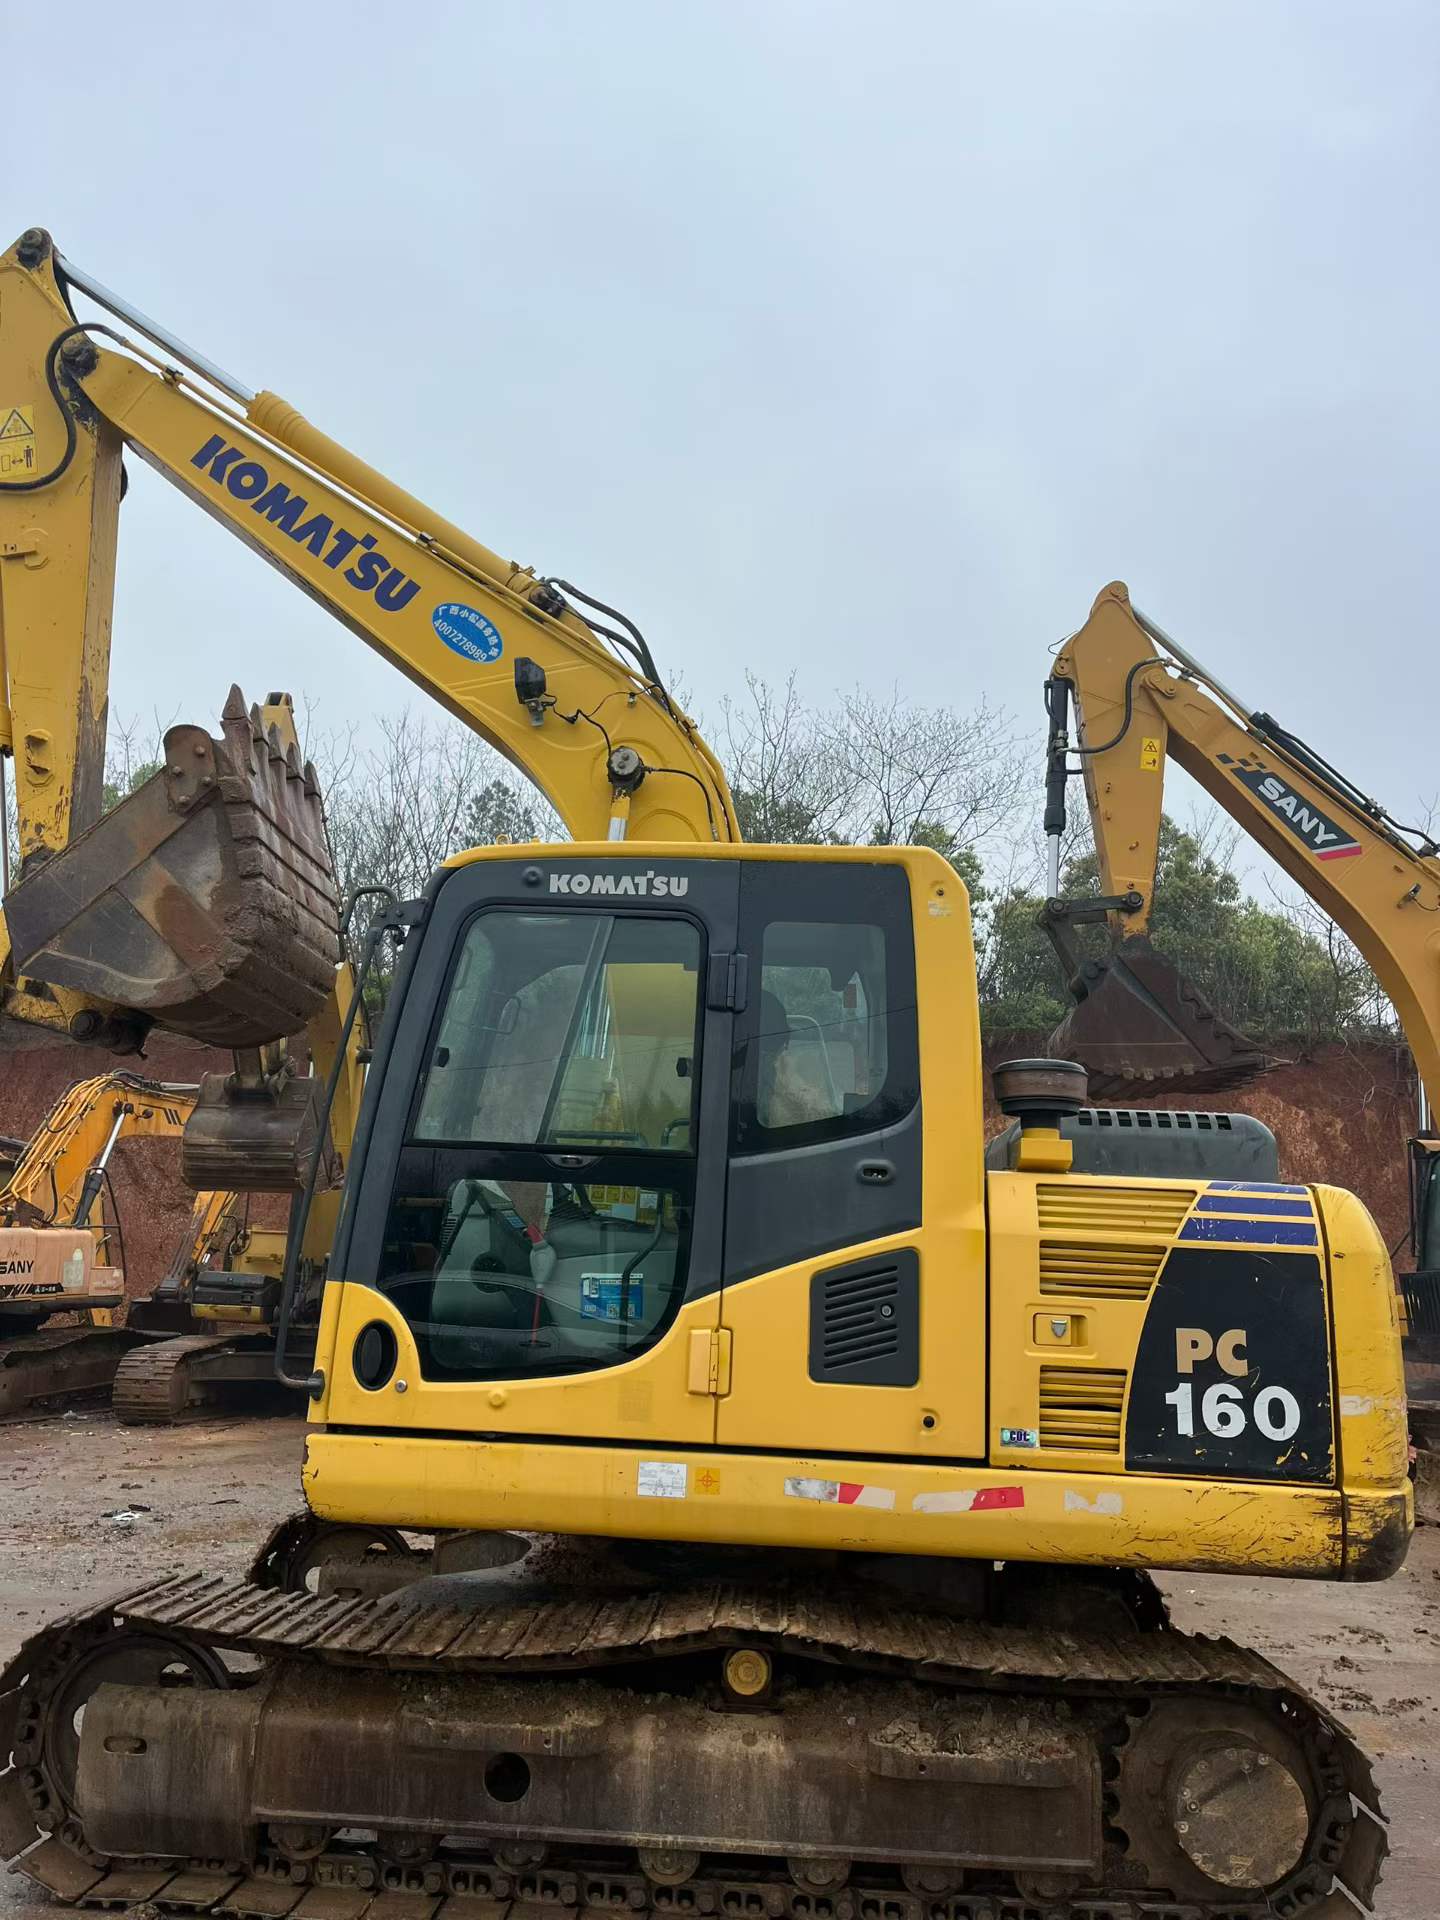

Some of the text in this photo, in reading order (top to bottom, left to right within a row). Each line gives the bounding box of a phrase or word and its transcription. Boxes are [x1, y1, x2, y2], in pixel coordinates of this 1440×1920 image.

[190, 433, 422, 612] KOMATSU
[433, 618, 488, 662] 4007278989
[1257, 777, 1339, 845] SANY
[549, 870, 689, 897] KOMATSU
[1175, 1327, 1249, 1377] PC
[1165, 1382, 1301, 1441] 160
